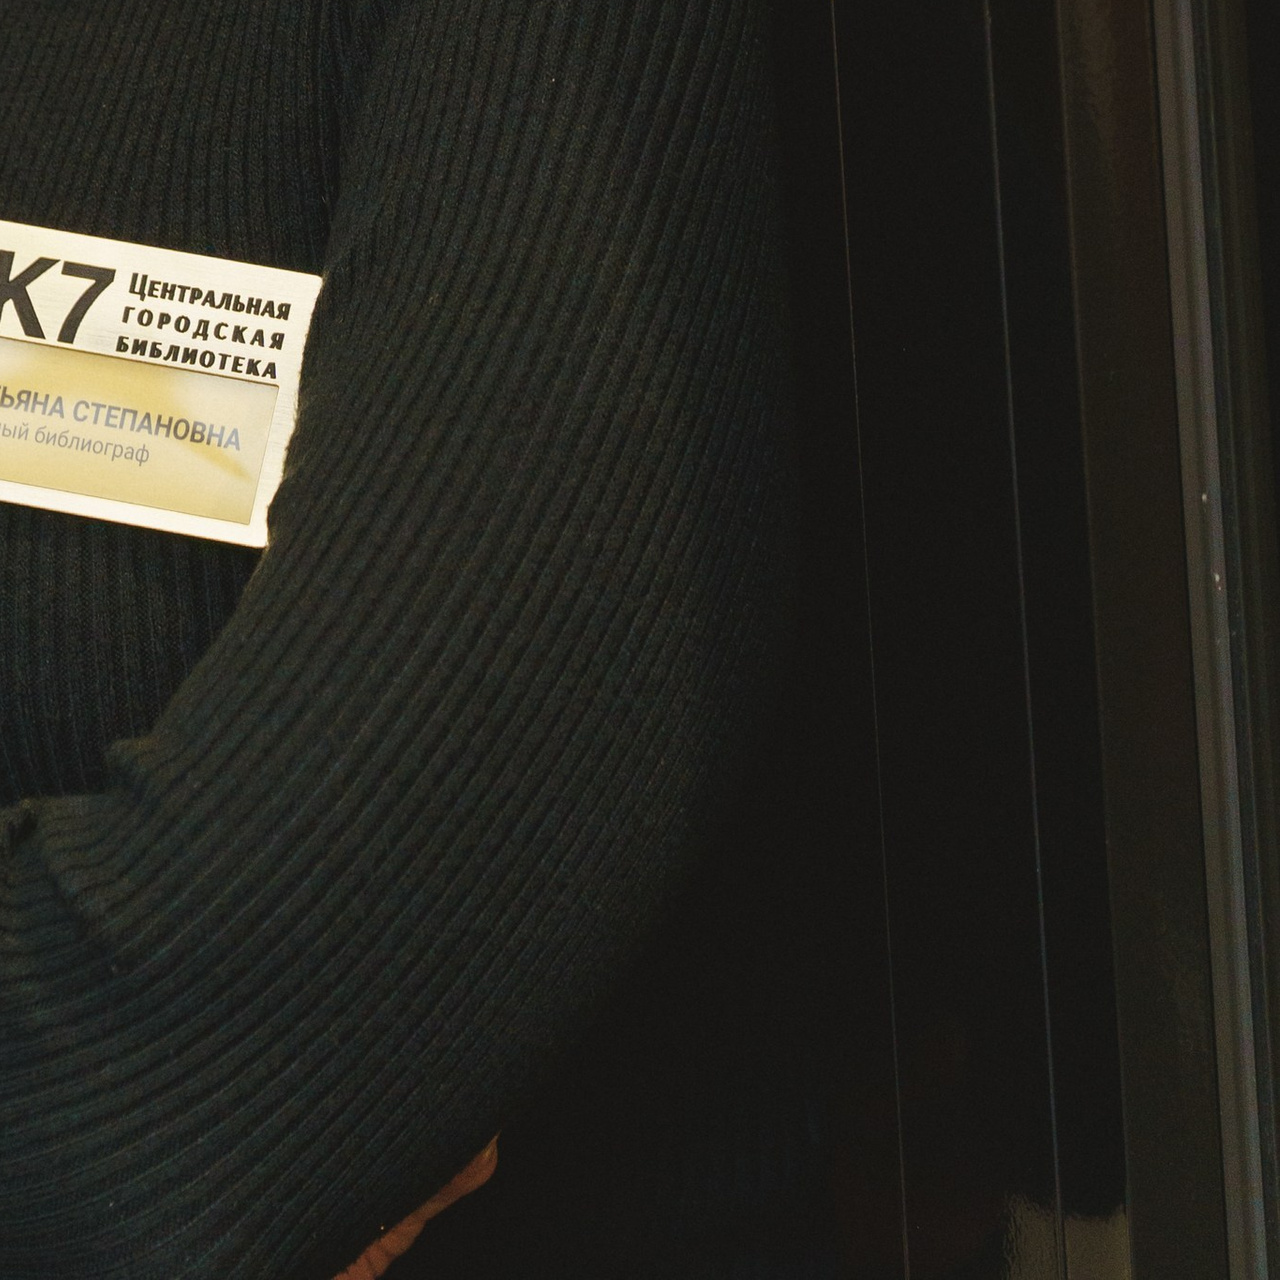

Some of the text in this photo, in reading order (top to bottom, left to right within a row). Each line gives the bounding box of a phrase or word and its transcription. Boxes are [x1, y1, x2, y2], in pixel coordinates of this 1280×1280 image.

[128, 272, 292, 321] ЦЕНТРАЛЬНАЯ
[122, 306, 286, 351] ГОРОДСКАЯ
[116, 336, 278, 379] БИБЛИОТЕКА
[34, 423, 151, 467] библиограф
[73, 400, 242, 451] СТЕПАНОВНА
